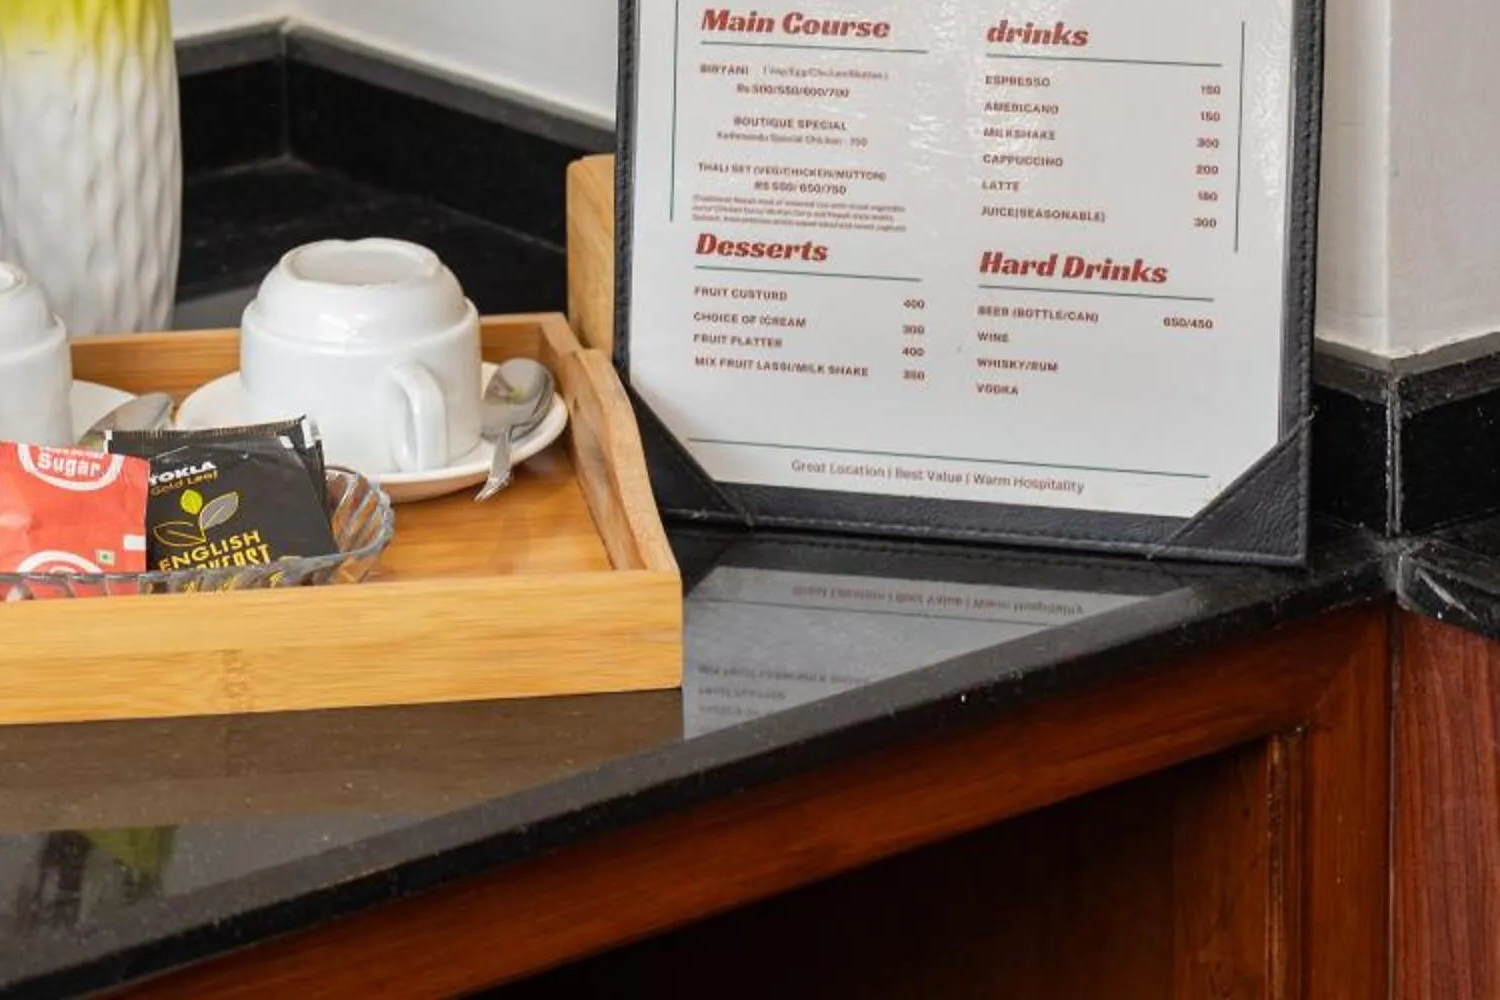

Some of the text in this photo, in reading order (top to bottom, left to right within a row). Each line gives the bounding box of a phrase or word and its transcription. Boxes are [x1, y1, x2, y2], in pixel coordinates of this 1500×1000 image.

[701, 8, 891, 38] Main Course
[987, 19, 1089, 46] drinks
[700, 64, 749, 75] BIRYANI
[985, 75, 1051, 87] ESPRESSO
[983, 102, 1059, 115] AMERICANO
[733, 117, 848, 131] BOUTIQUE SPECIAL
[983, 128, 1055, 140] MILKSHAKE
[983, 154, 1063, 167] CAPPUCCINO
[699, 162, 730, 173] THALI
[732, 164, 751, 174] SET
[982, 181, 1020, 192] LATTE
[695, 233, 829, 261] Desserts
[980, 251, 1169, 284] Hard Drinks
[694, 286, 729, 297] FRUIT
[693, 312, 738, 324] CHOICE
[741, 314, 756, 325] OF
[978, 305, 1099, 322] BEER (BOTTLE/CAN)
[693, 334, 783, 348] FRUIT PLATTER
[978, 331, 1009, 343] WINE
[695, 356, 869, 377] MIX FRUIT LASSI/MILK SHAKE
[977, 358, 1058, 372] WHISKY/RUM
[977, 384, 1019, 396] VODKA
[37, 452, 101, 477] Sugar
[151, 469, 219, 496] Gold Leaf
[791, 459, 827, 473] Great
[830, 461, 884, 477] Location
[895, 467, 924, 481] Best
[928, 470, 963, 483] Value
[973, 473, 1011, 486] Warm
[1013, 475, 1086, 495] Hospitality
[158, 530, 261, 573] ENGLISH
